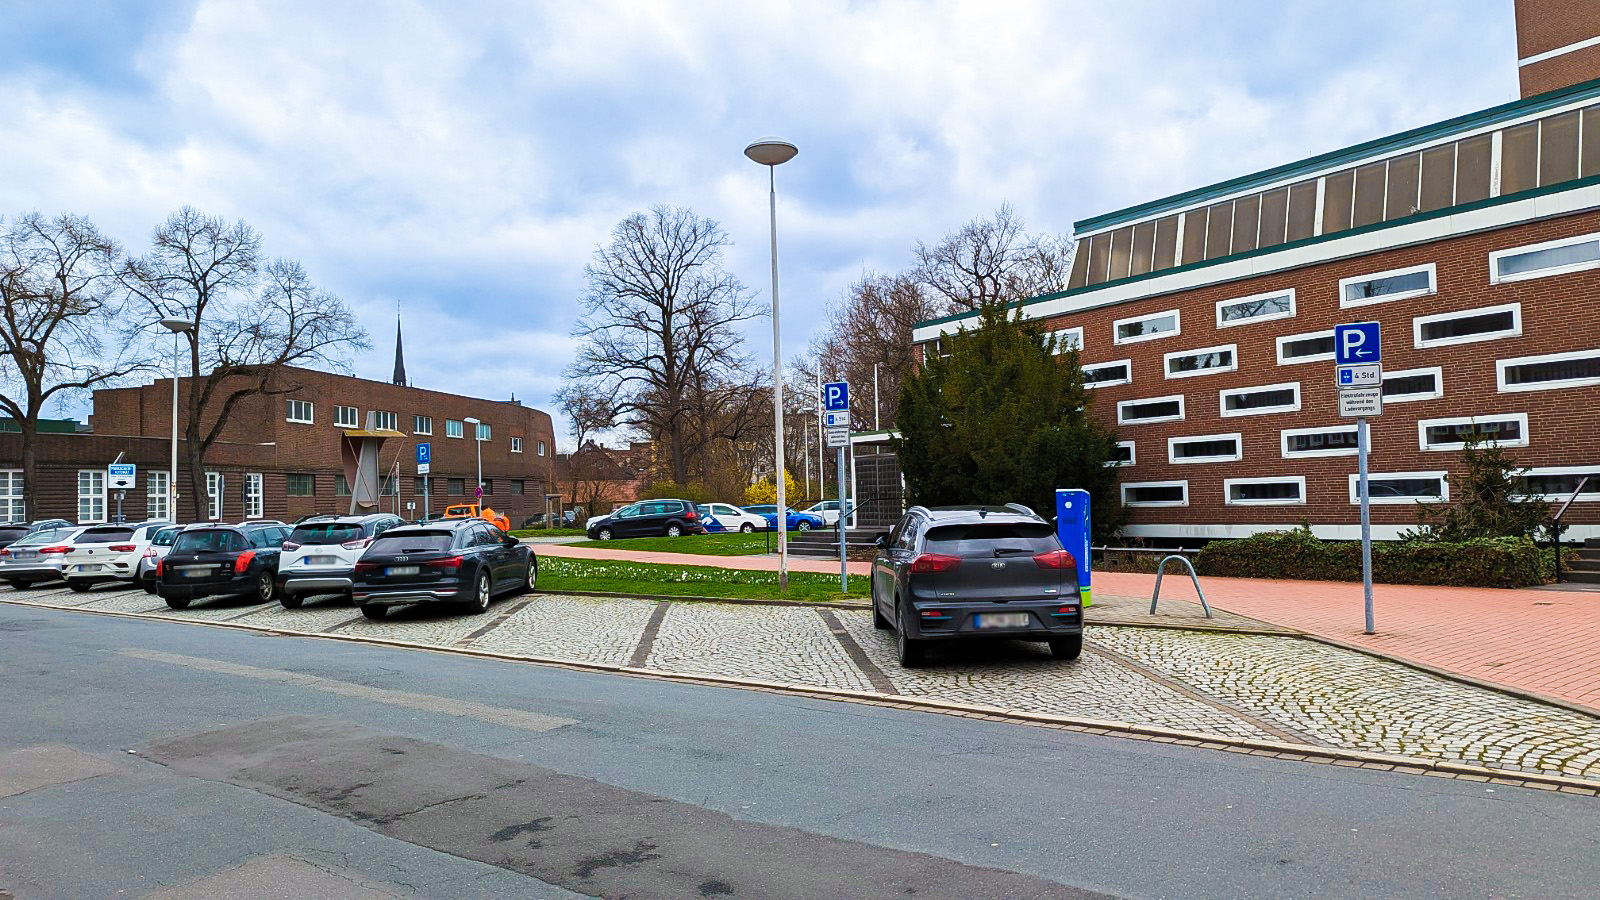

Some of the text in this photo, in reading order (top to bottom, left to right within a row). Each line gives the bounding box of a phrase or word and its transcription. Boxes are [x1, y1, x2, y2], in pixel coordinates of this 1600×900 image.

[1343, 329, 1366, 359] P
[829, 386, 841, 407] P
[419, 446, 427, 461] P
